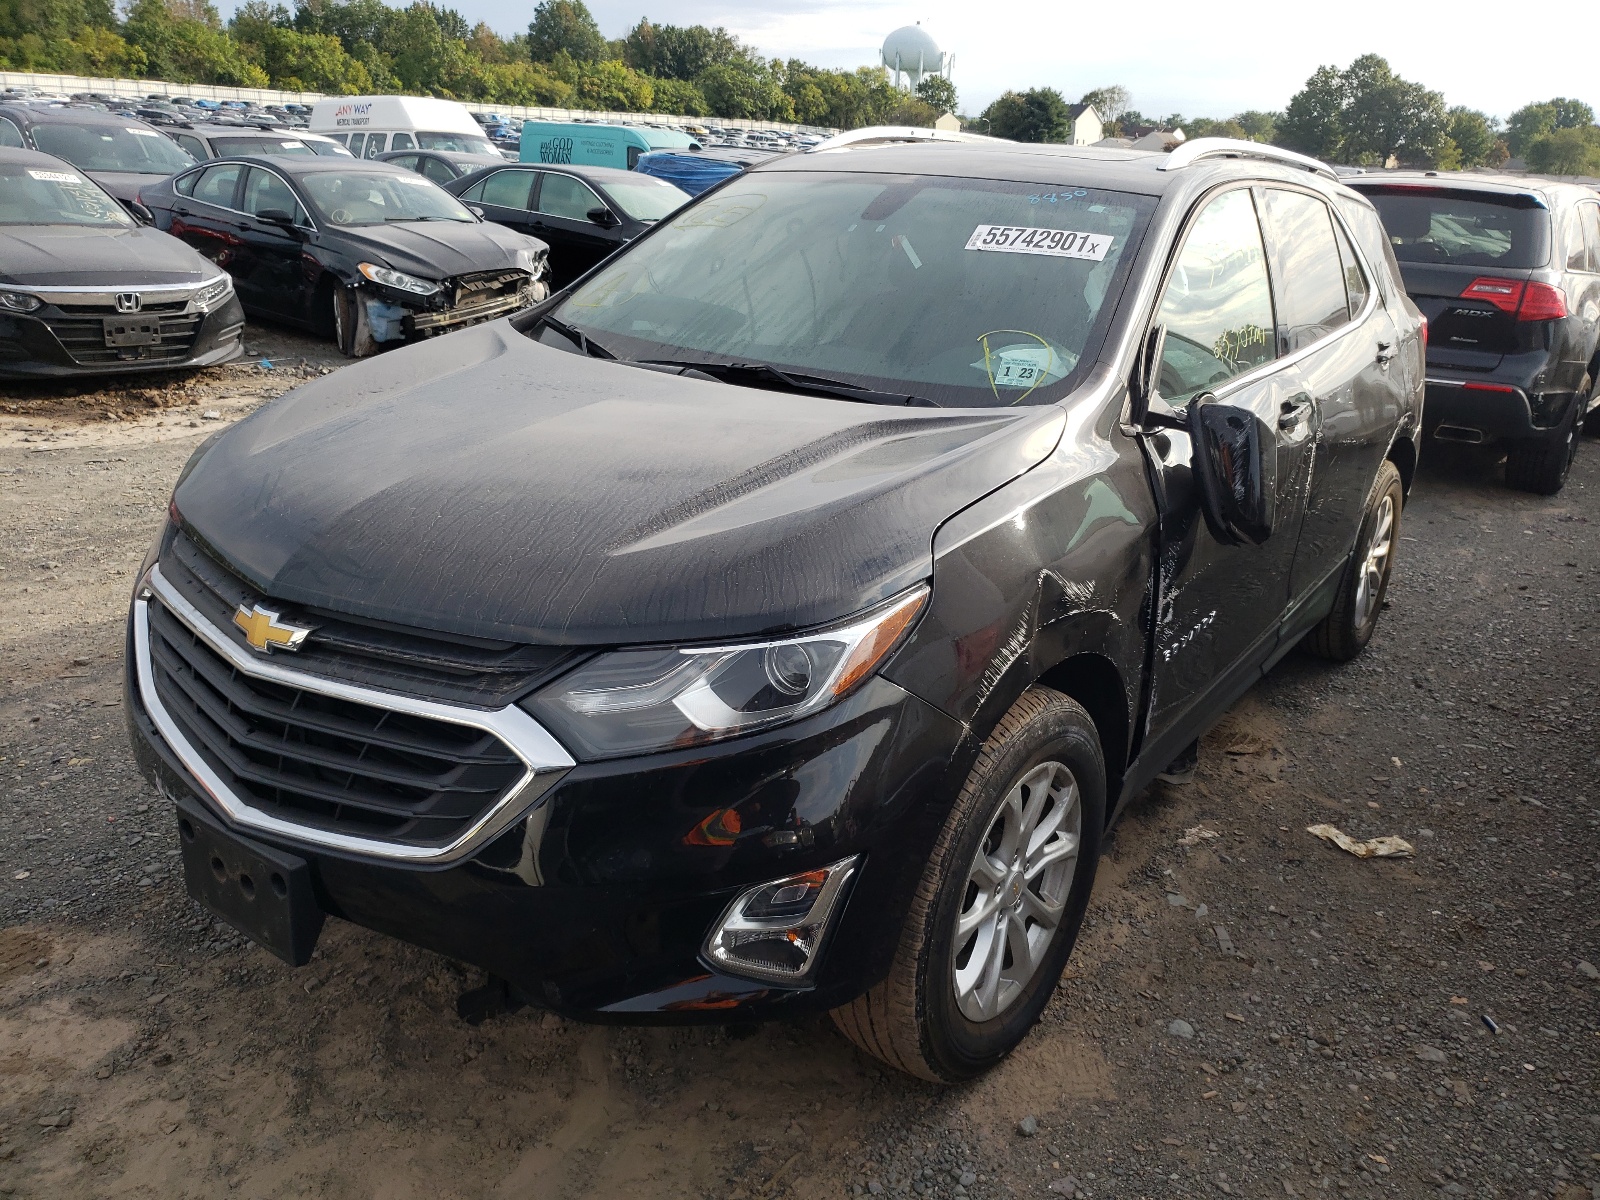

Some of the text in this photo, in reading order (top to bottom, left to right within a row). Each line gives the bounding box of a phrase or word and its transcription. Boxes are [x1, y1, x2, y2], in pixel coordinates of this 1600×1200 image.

[336, 103, 372, 116] ANY WAY
[552, 138, 573, 150] GOD
[541, 151, 571, 164] WOMAN
[1453, 309, 1494, 318] MDX
[1003, 366, 1034, 379] 1 23
